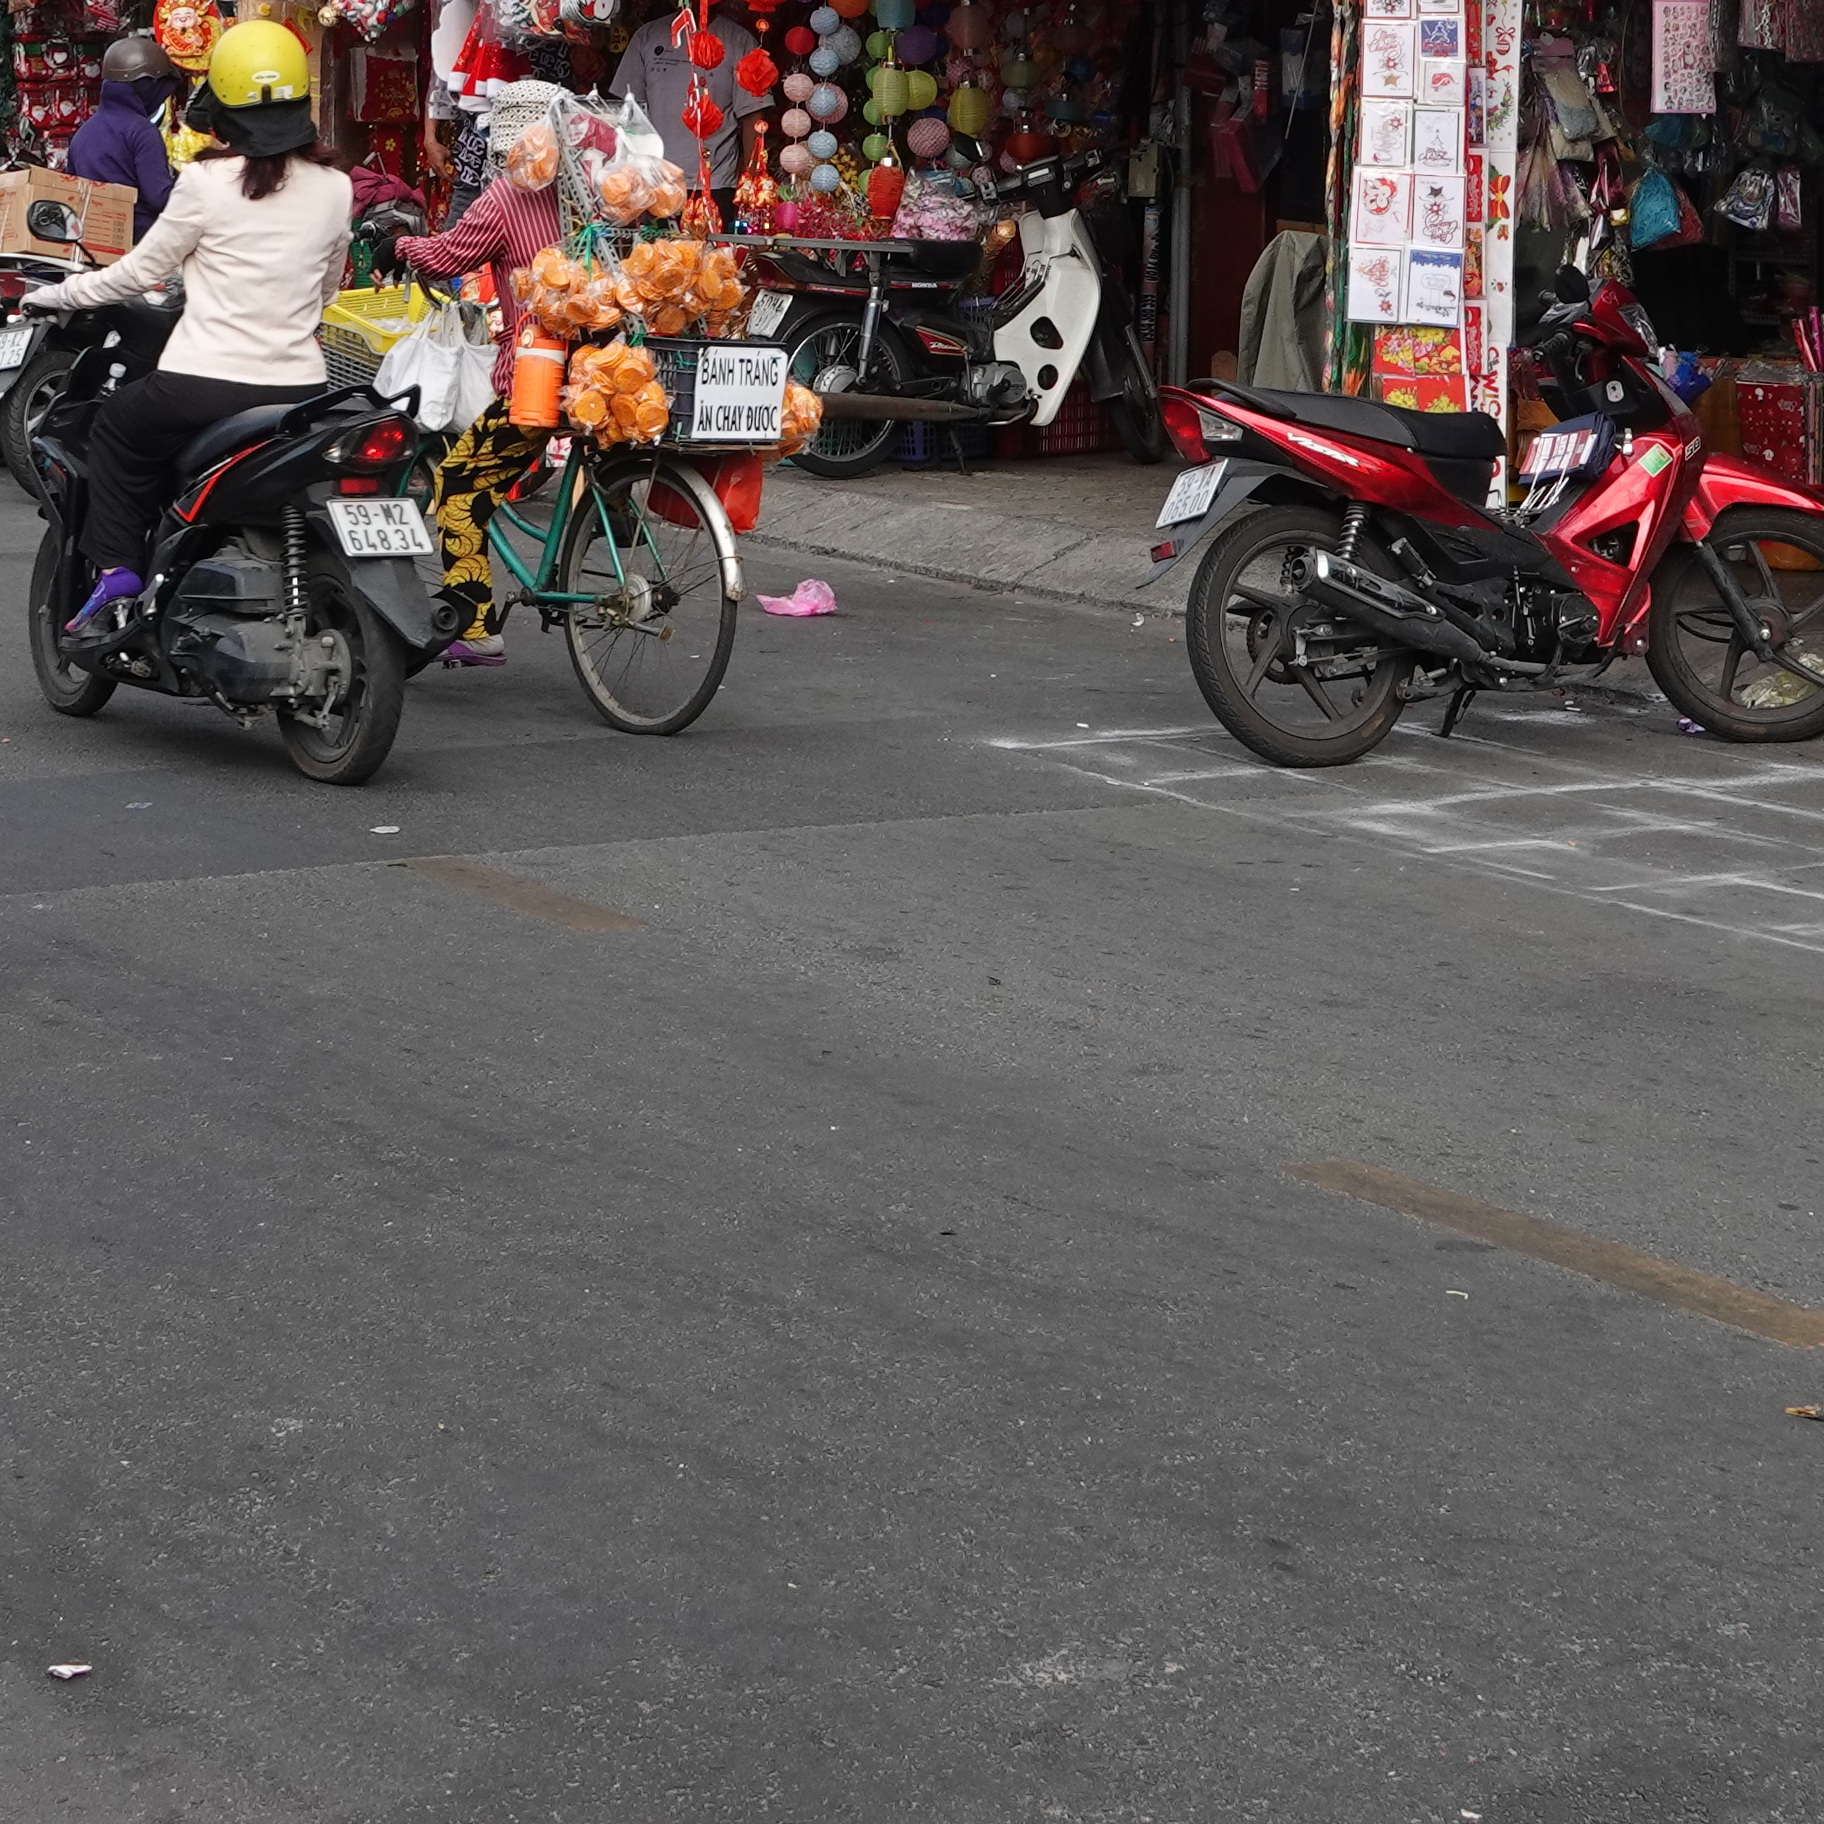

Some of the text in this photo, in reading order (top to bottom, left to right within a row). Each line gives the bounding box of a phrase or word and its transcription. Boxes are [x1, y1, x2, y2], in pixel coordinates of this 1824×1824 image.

[701, 348, 778, 387] BÁNH TRÁNG
[697, 400, 778, 438] ĂN CHAY ĐƯỢC
[348, 528, 424, 551] 648.34
